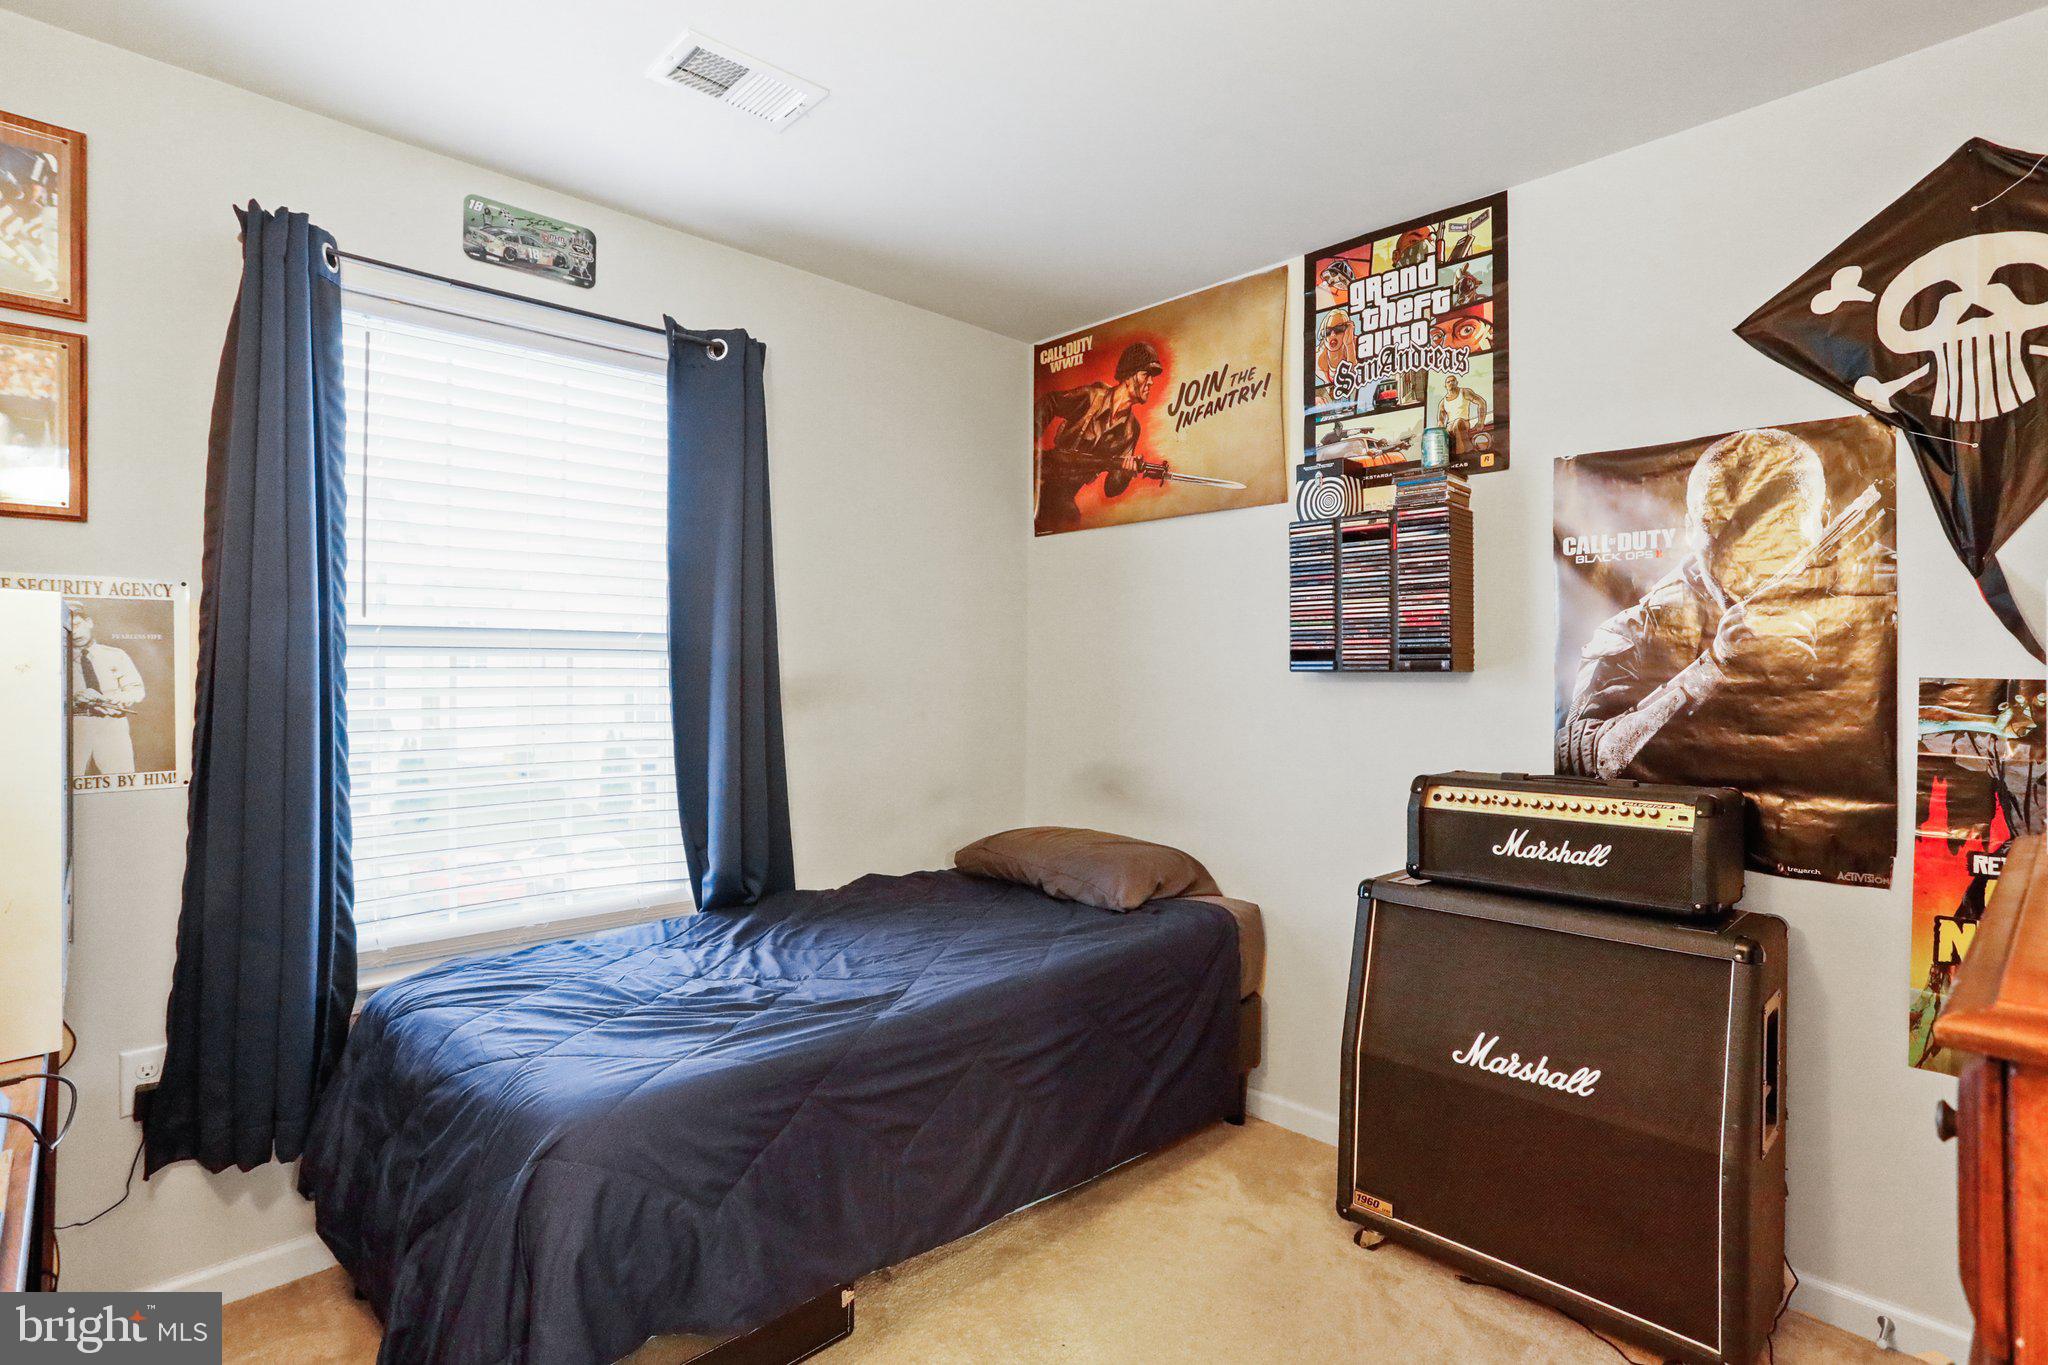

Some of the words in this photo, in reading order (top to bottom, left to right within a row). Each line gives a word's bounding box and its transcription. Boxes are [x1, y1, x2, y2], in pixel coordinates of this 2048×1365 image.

[468, 199, 484, 212] 18
[528, 247, 540, 260] 18
[1040, 345, 1064, 365] CALL
[1066, 335, 1093, 357] DUTY
[1357, 319, 1428, 359] auto
[1050, 353, 1084, 374] WWII
[1333, 360, 1380, 399] San
[1380, 342, 1469, 377] Andreas
[1168, 364, 1228, 416] JOIN
[1231, 366, 1256, 387] THE
[1176, 373, 1271, 433] INFANTRY!
[1562, 534, 1611, 556] CALL
[1617, 528, 1676, 552] DUTY
[1575, 553, 1622, 564] BLACK
[1625, 550, 1653, 560] OPS
[16, 577, 103, 595] SECURITY
[109, 581, 173, 598] AGENCY
[73, 776, 110, 790] GETS
[117, 774, 136, 787] BY
[144, 772, 176, 785] HIM!
[1492, 828, 1612, 867] Marshall
[1452, 1032, 1602, 1097] Marshall
[1356, 1193, 1380, 1209] 1960
